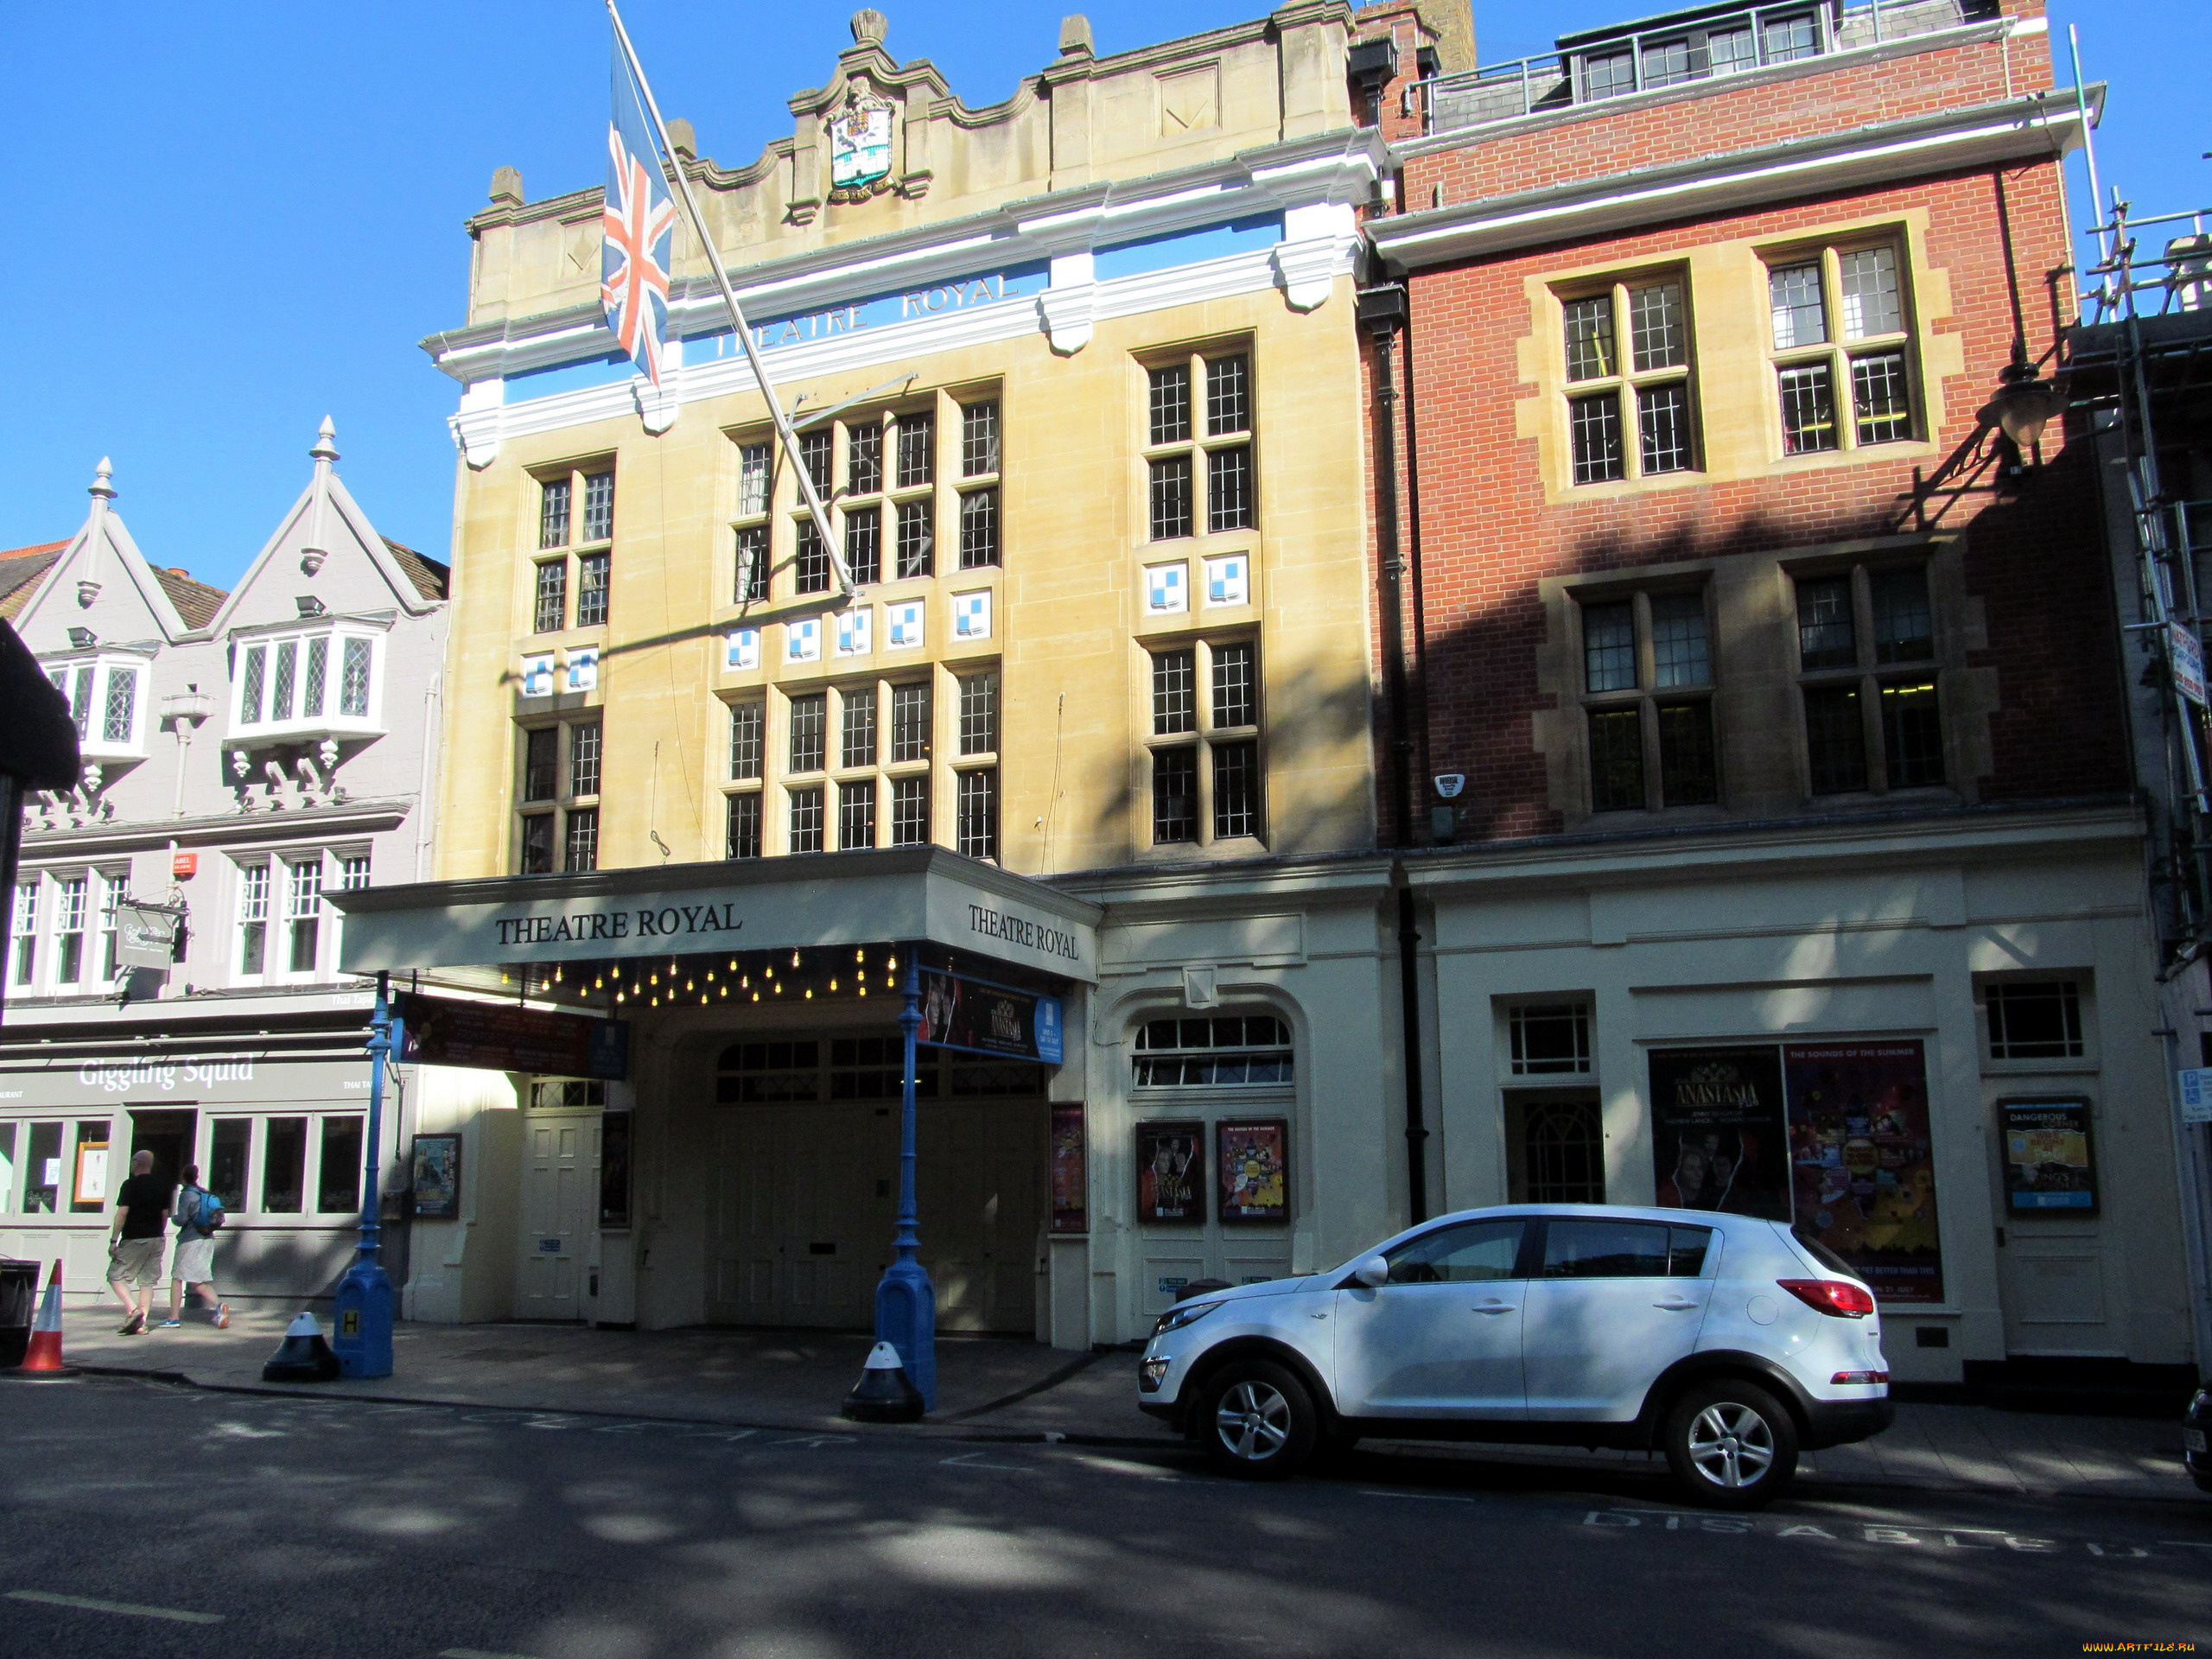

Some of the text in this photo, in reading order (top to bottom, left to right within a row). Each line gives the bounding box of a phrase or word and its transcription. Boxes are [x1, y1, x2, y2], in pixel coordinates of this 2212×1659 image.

[711, 273, 1019, 357] THEATRE ROYAL
[496, 904, 743, 944] THEATRE ROYAL
[969, 904, 1079, 961] THEATRE ROYAL
[331, 995, 351, 1005] Thai
[79, 1052, 254, 1091] Giggling Squid
[1675, 1082, 1758, 1104] ANASTASIA
[2010, 1112, 2068, 1122] DANGEROUS
[1920, 1266, 1935, 1274] THIS
[345, 1313, 358, 1332] H
